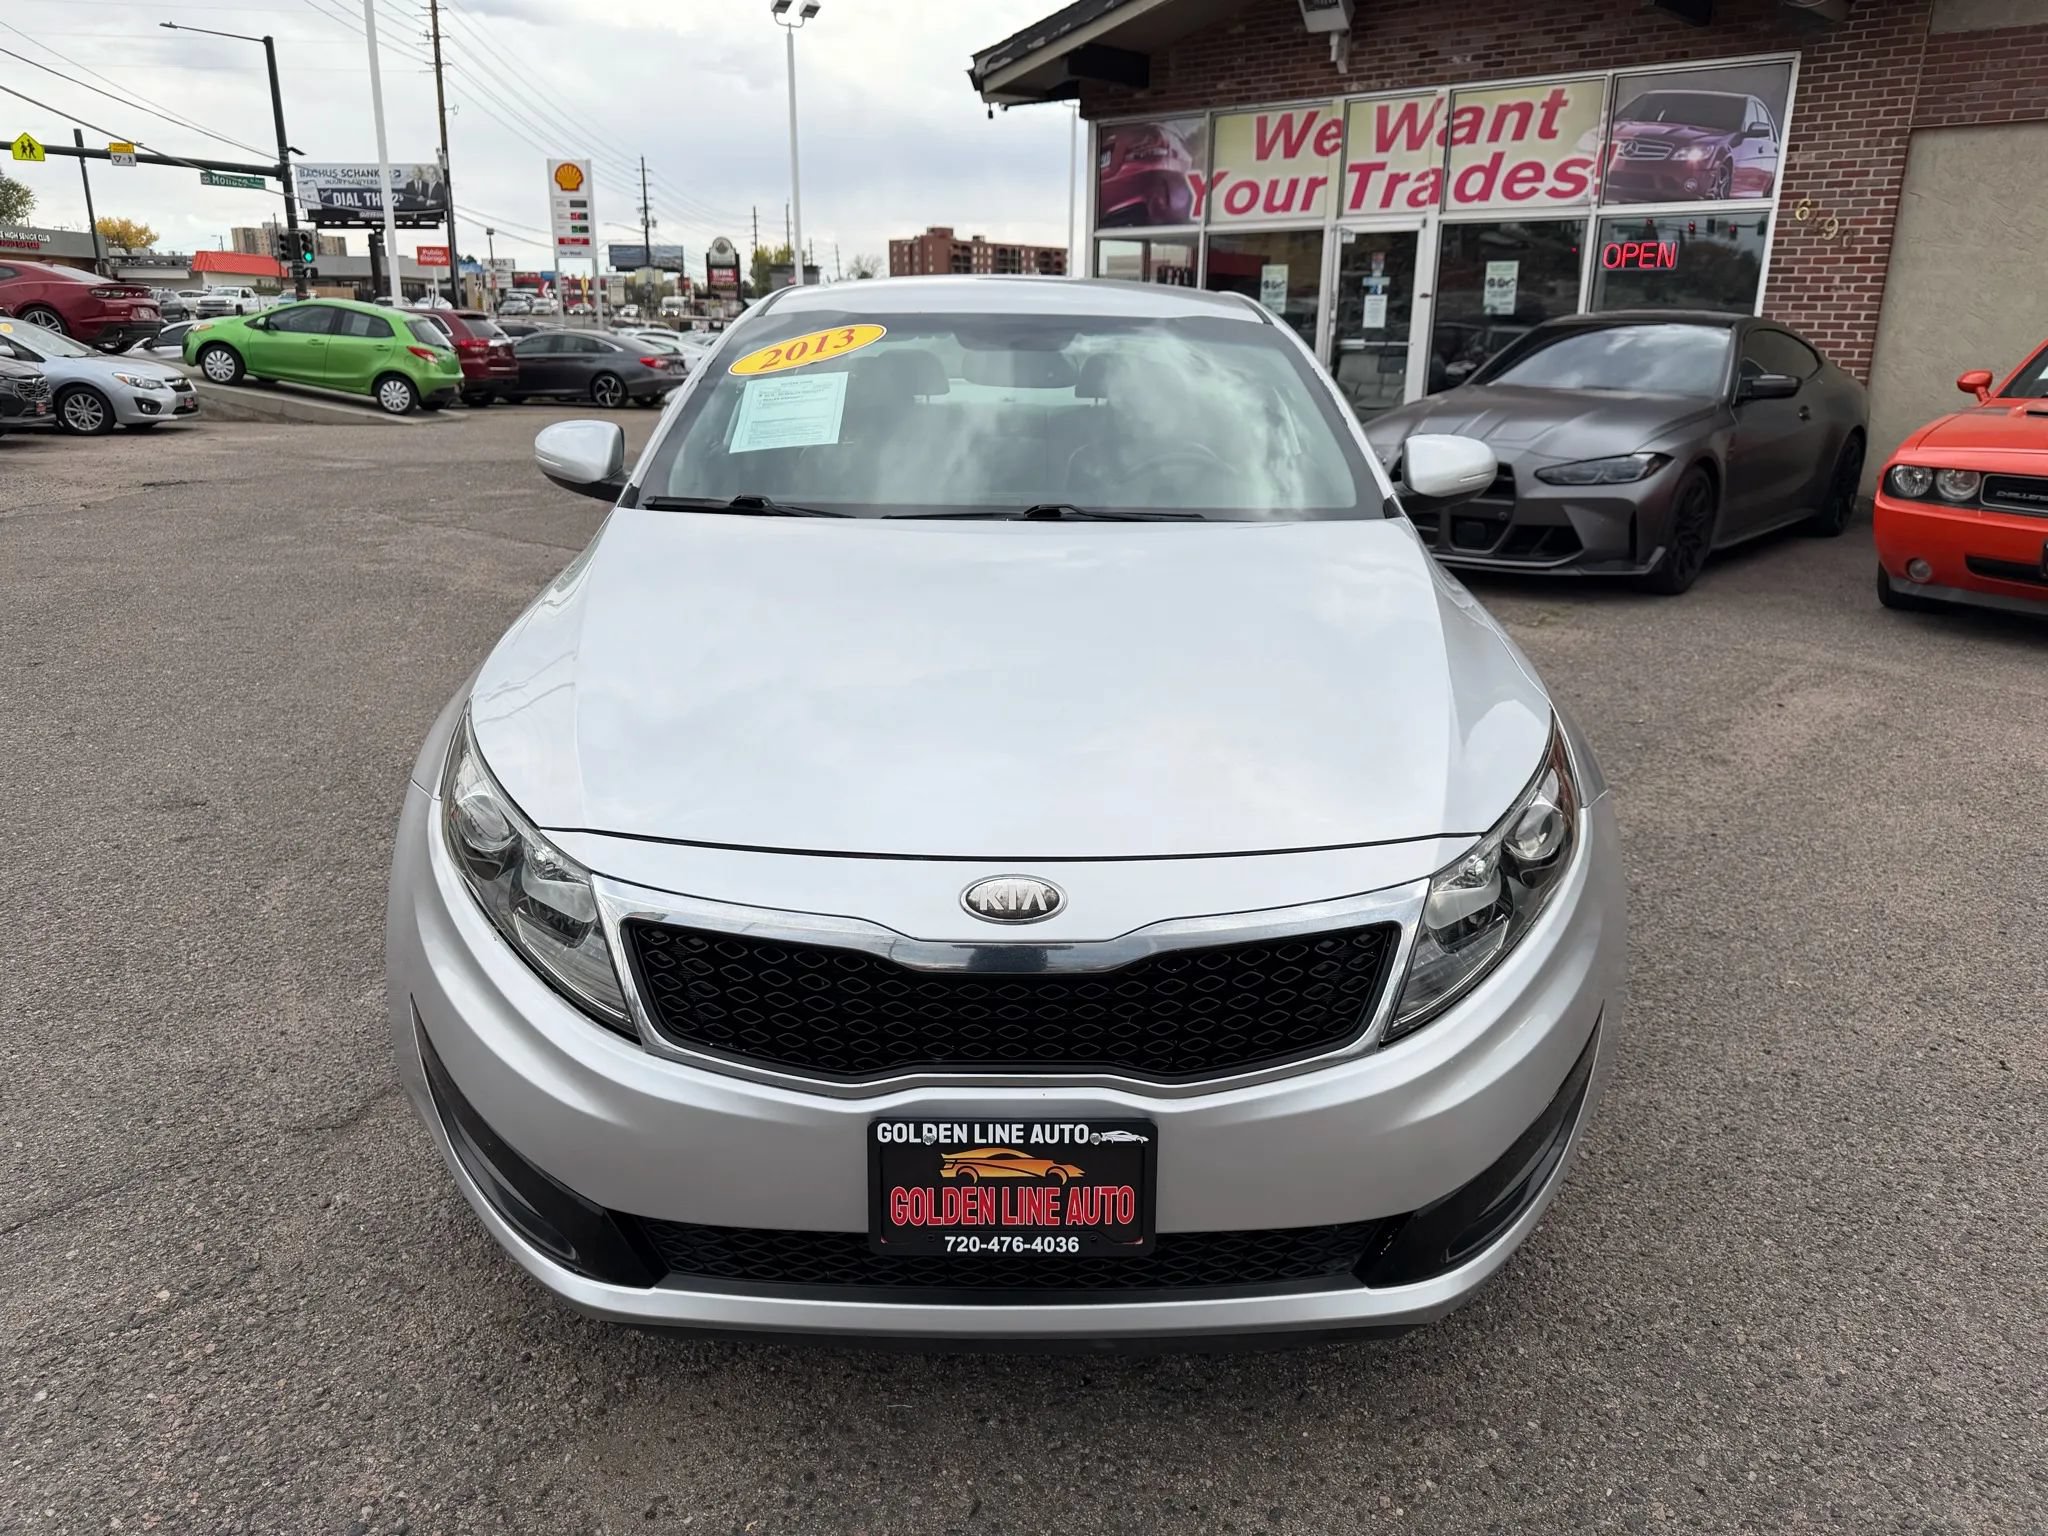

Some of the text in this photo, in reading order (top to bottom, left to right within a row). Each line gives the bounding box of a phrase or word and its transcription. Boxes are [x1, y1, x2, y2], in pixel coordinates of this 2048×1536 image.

[1255, 88, 1570, 162] We Want
[332, 192, 360, 207] DIAL
[363, 192, 385, 207] TH
[1187, 169, 1328, 218] Your
[1602, 241, 1678, 269] OPEN
[758, 328, 856, 370] 2013
[979, 884, 1048, 911] KIA
[876, 1122, 1089, 1145] GOLDEN LINE AUTO
[890, 1185, 1135, 1227] GOLDEN LINE AUTO
[944, 1236, 1080, 1253] 720-476-4036
